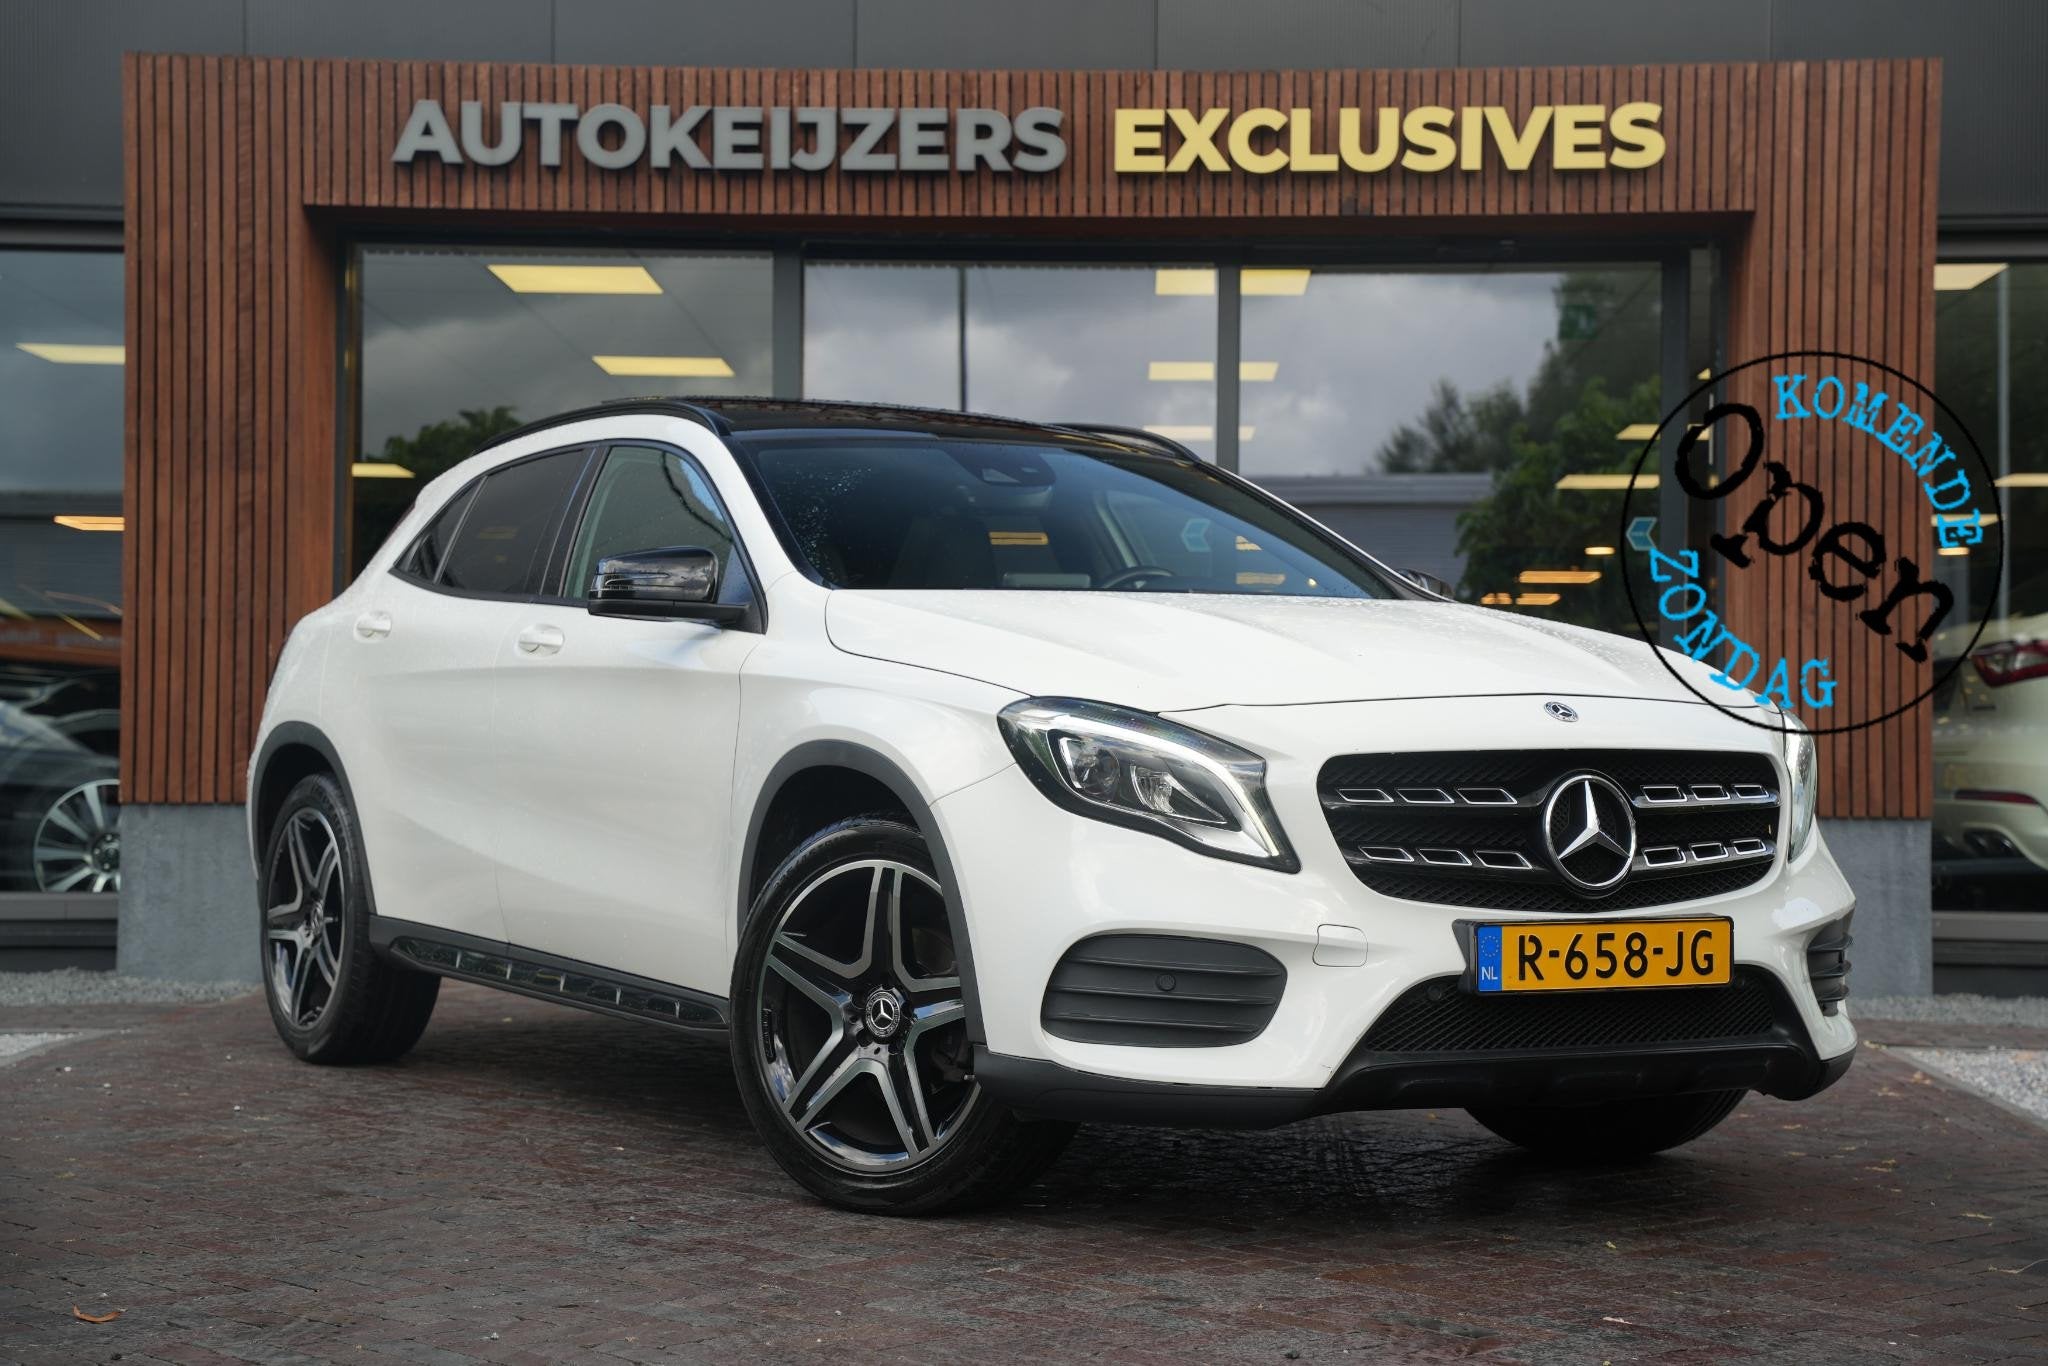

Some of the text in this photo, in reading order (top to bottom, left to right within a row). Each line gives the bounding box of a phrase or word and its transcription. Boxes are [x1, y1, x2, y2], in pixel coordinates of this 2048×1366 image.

[391, 99, 1667, 174] AUTOKEIJZERS EXCLUSIVES
[1481, 929, 1714, 981] NL R-658-JG
